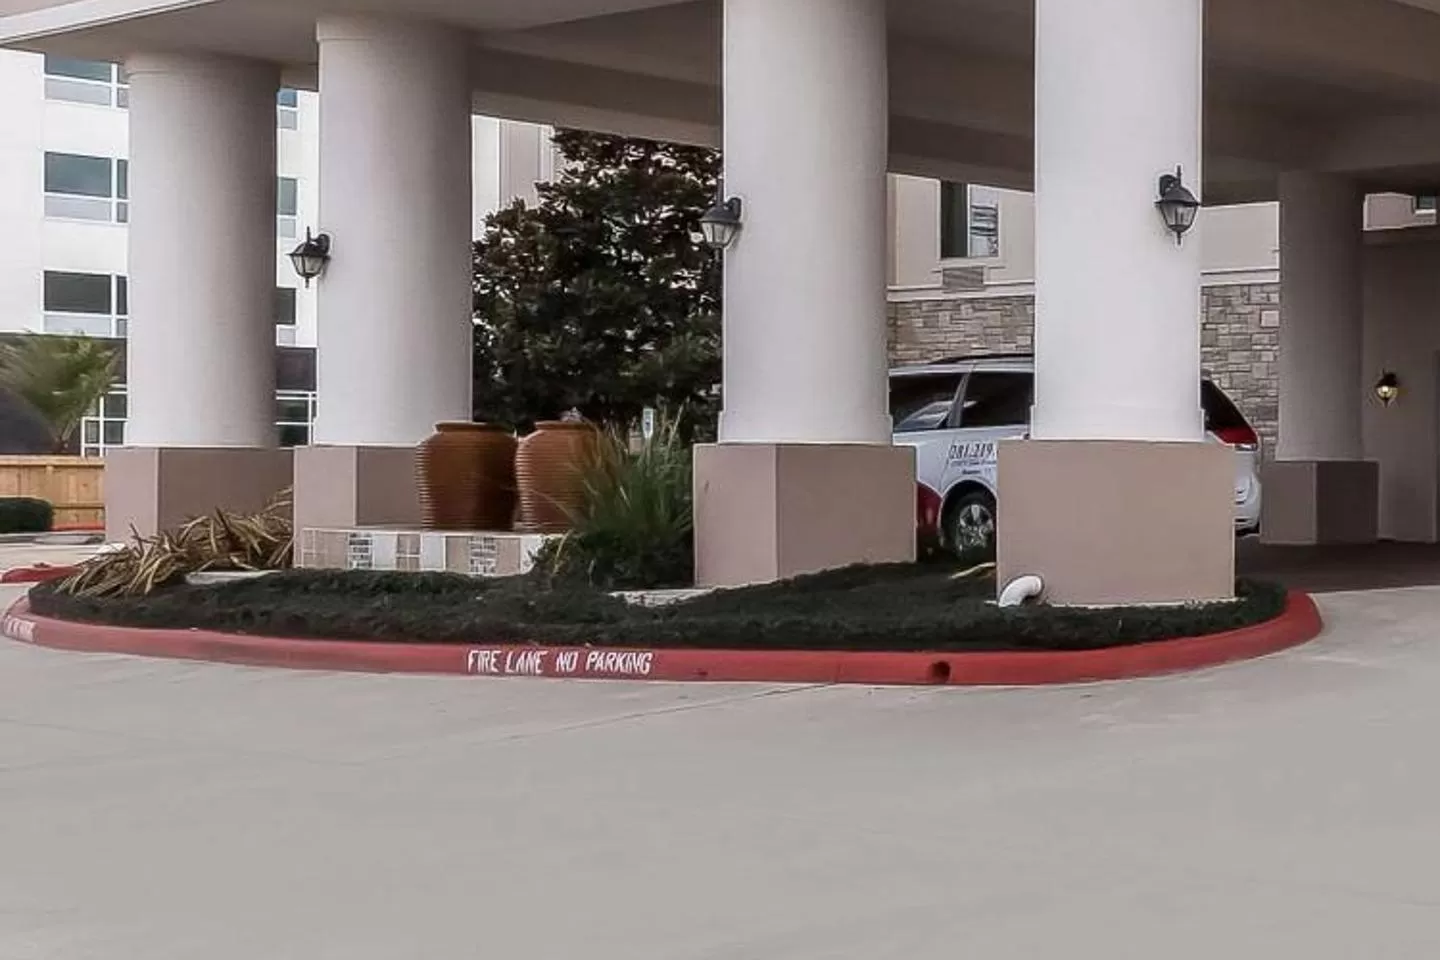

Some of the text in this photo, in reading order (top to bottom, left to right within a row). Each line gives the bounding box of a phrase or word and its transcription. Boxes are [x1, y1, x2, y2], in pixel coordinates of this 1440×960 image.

[467, 649, 653, 675] FIRE LANE NO PARKING
